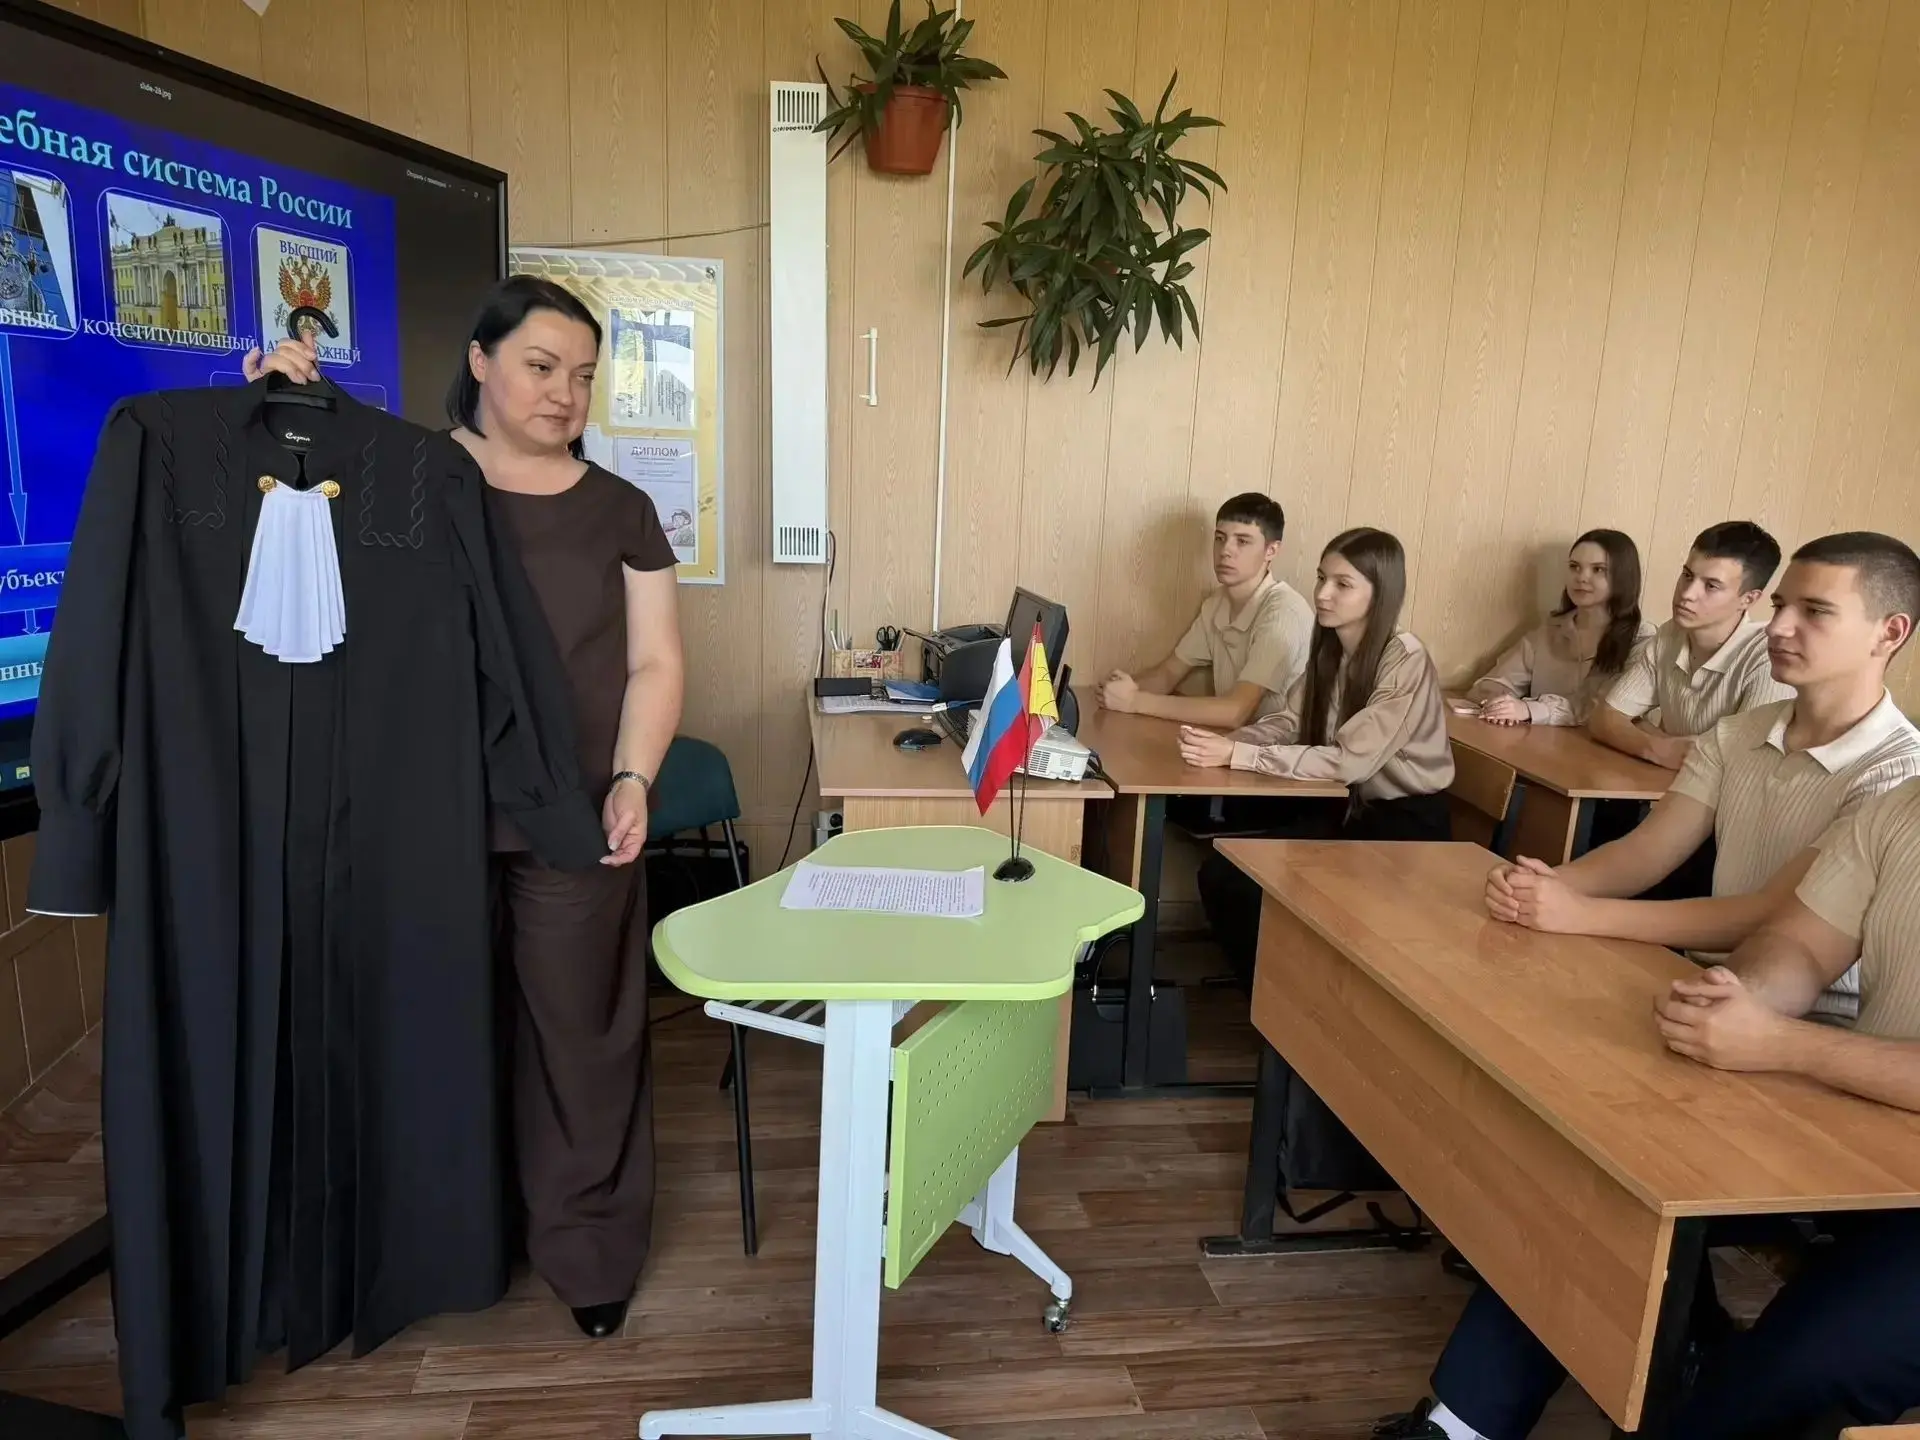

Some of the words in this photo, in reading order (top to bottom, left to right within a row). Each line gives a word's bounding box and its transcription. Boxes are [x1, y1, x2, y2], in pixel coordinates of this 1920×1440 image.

[0, 109, 114, 170] ебная
[123, 150, 253, 205] система
[259, 175, 353, 229] России
[279, 239, 338, 265] ВЫСШИЙ
[82, 318, 256, 351] КОНСТИТУЦИОННЫЙ
[630, 446, 680, 458] ДИПЛОМ
